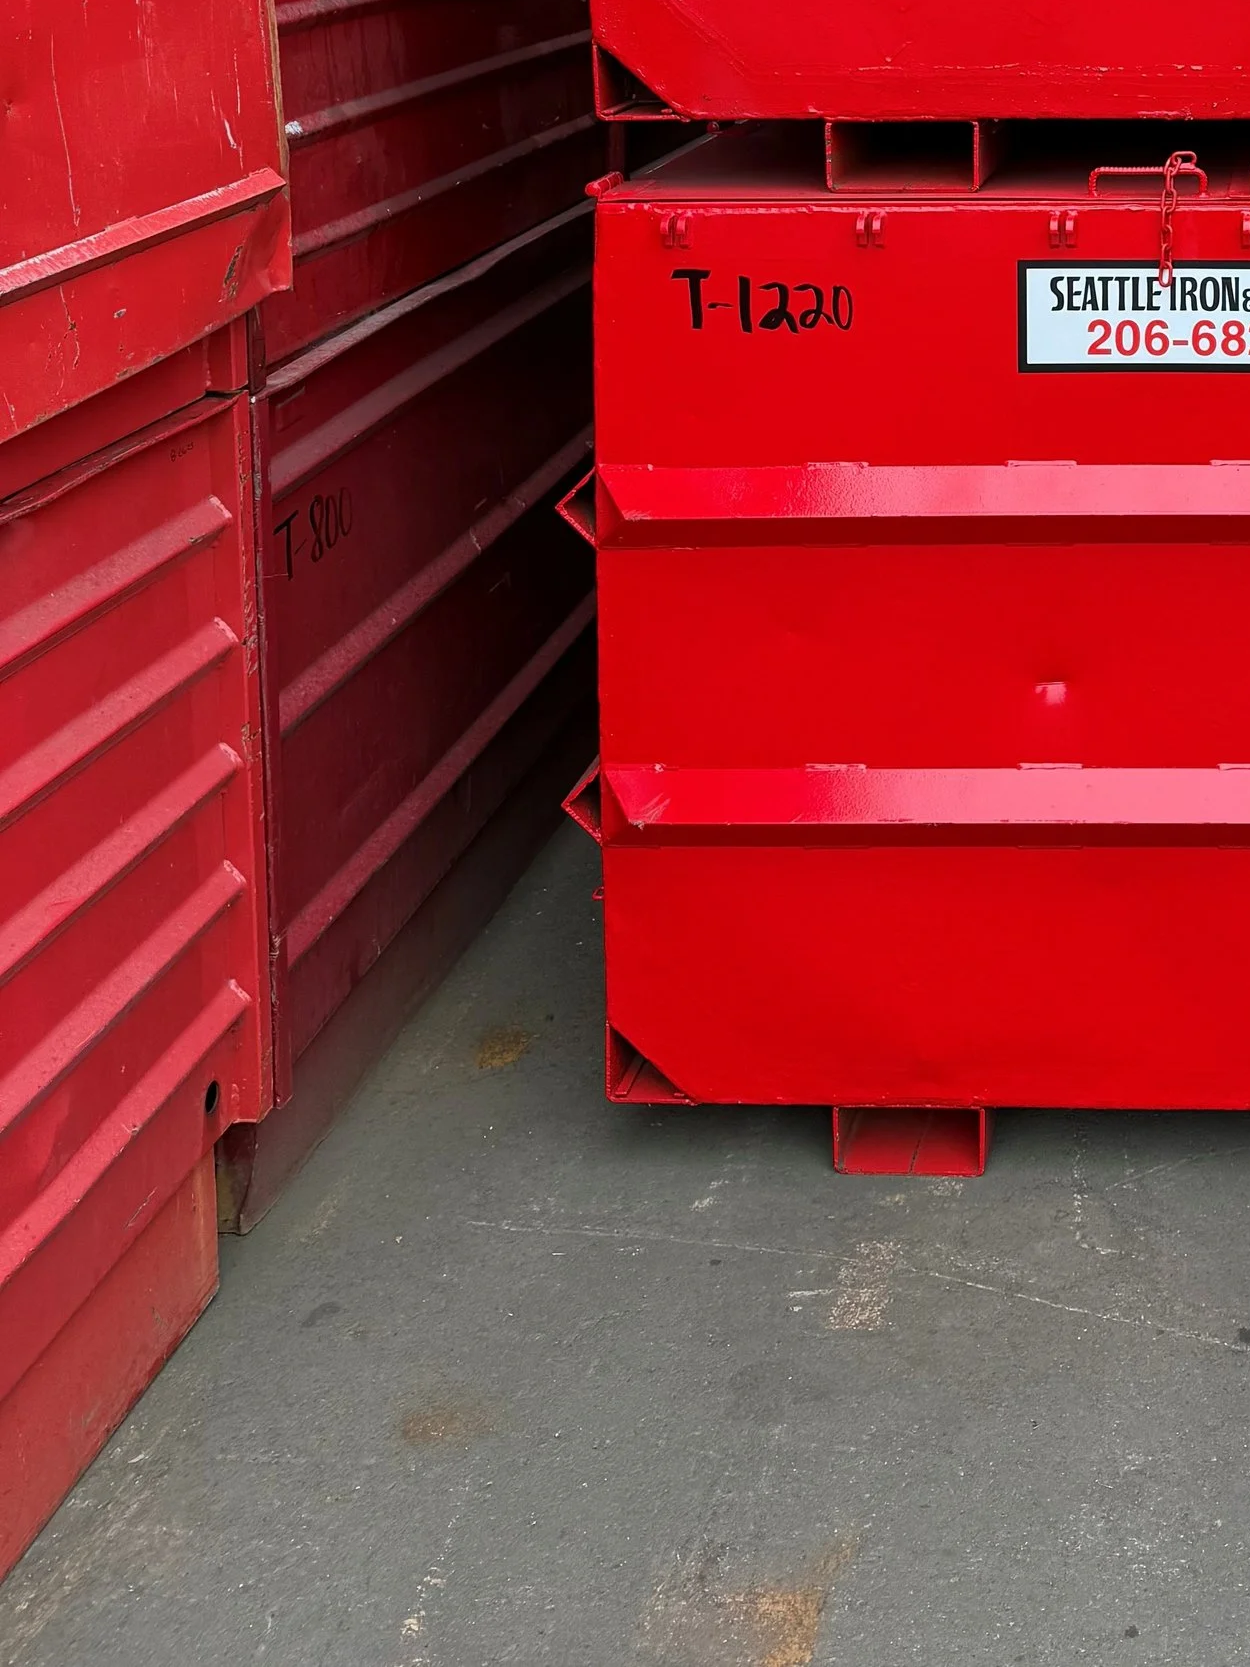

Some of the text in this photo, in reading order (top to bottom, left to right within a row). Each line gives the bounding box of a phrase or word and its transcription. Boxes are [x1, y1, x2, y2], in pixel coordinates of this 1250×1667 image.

[670, 268, 853, 334] T-1220
[1049, 275, 1162, 312] SEATTLE
[272, 486, 353, 581] T-800
